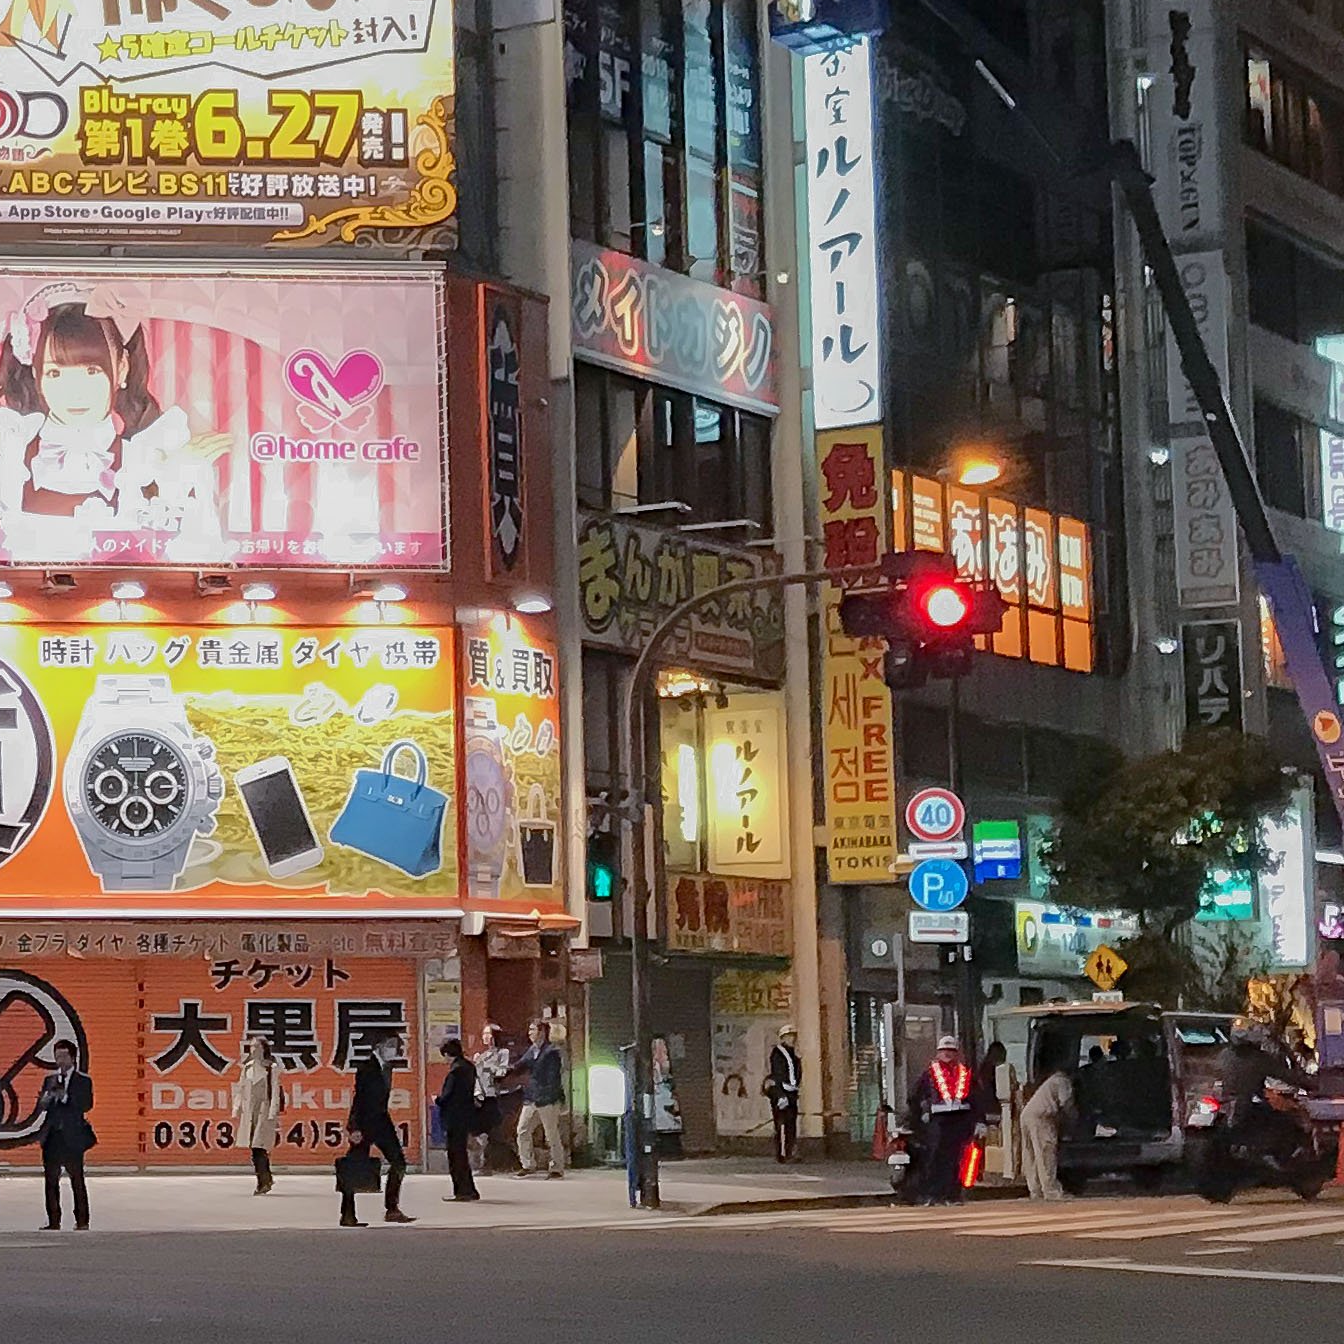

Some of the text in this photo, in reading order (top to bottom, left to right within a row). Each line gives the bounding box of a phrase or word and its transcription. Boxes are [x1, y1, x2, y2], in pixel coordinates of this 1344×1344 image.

[84, 89, 188, 118] Blu-ray
[85, 119, 190, 158] 第1巻
[194, 89, 362, 161] 6.27
[8, 205, 46, 221] App
[817, 134, 869, 365] ルノアール
[360, 434, 421, 462] cafe
[42, 638, 94, 666] 時計
[199, 637, 280, 666] 貴金属
[294, 637, 372, 666] ダイヤ
[862, 696, 890, 803] FREE
[921, 805, 952, 826] 40
[211, 958, 352, 992] チケット
[148, 998, 413, 1075] 大黒屋
